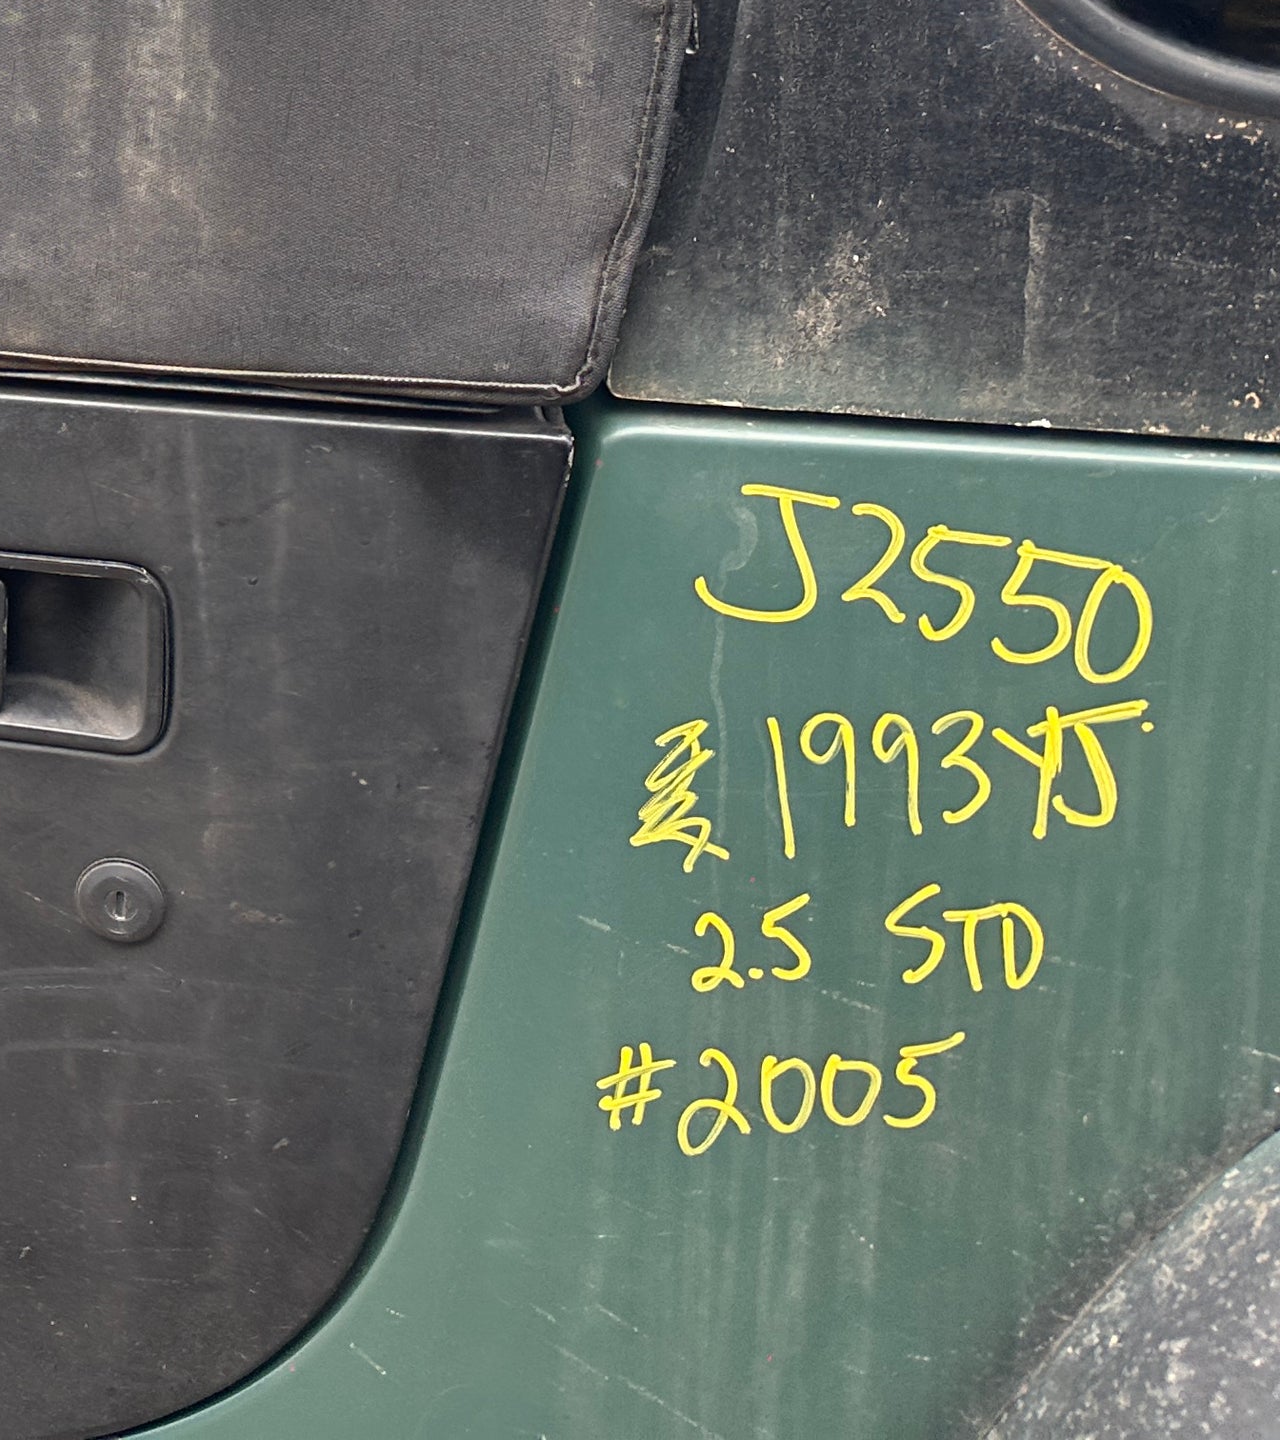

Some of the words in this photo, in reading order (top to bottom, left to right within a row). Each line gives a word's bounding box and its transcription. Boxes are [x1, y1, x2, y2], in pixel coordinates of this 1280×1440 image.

[694, 483, 1153, 685] J2550
[691, 893, 812, 993] 2.5
[885, 883, 1045, 993] STD
[596, 1031, 966, 1157] #2005
